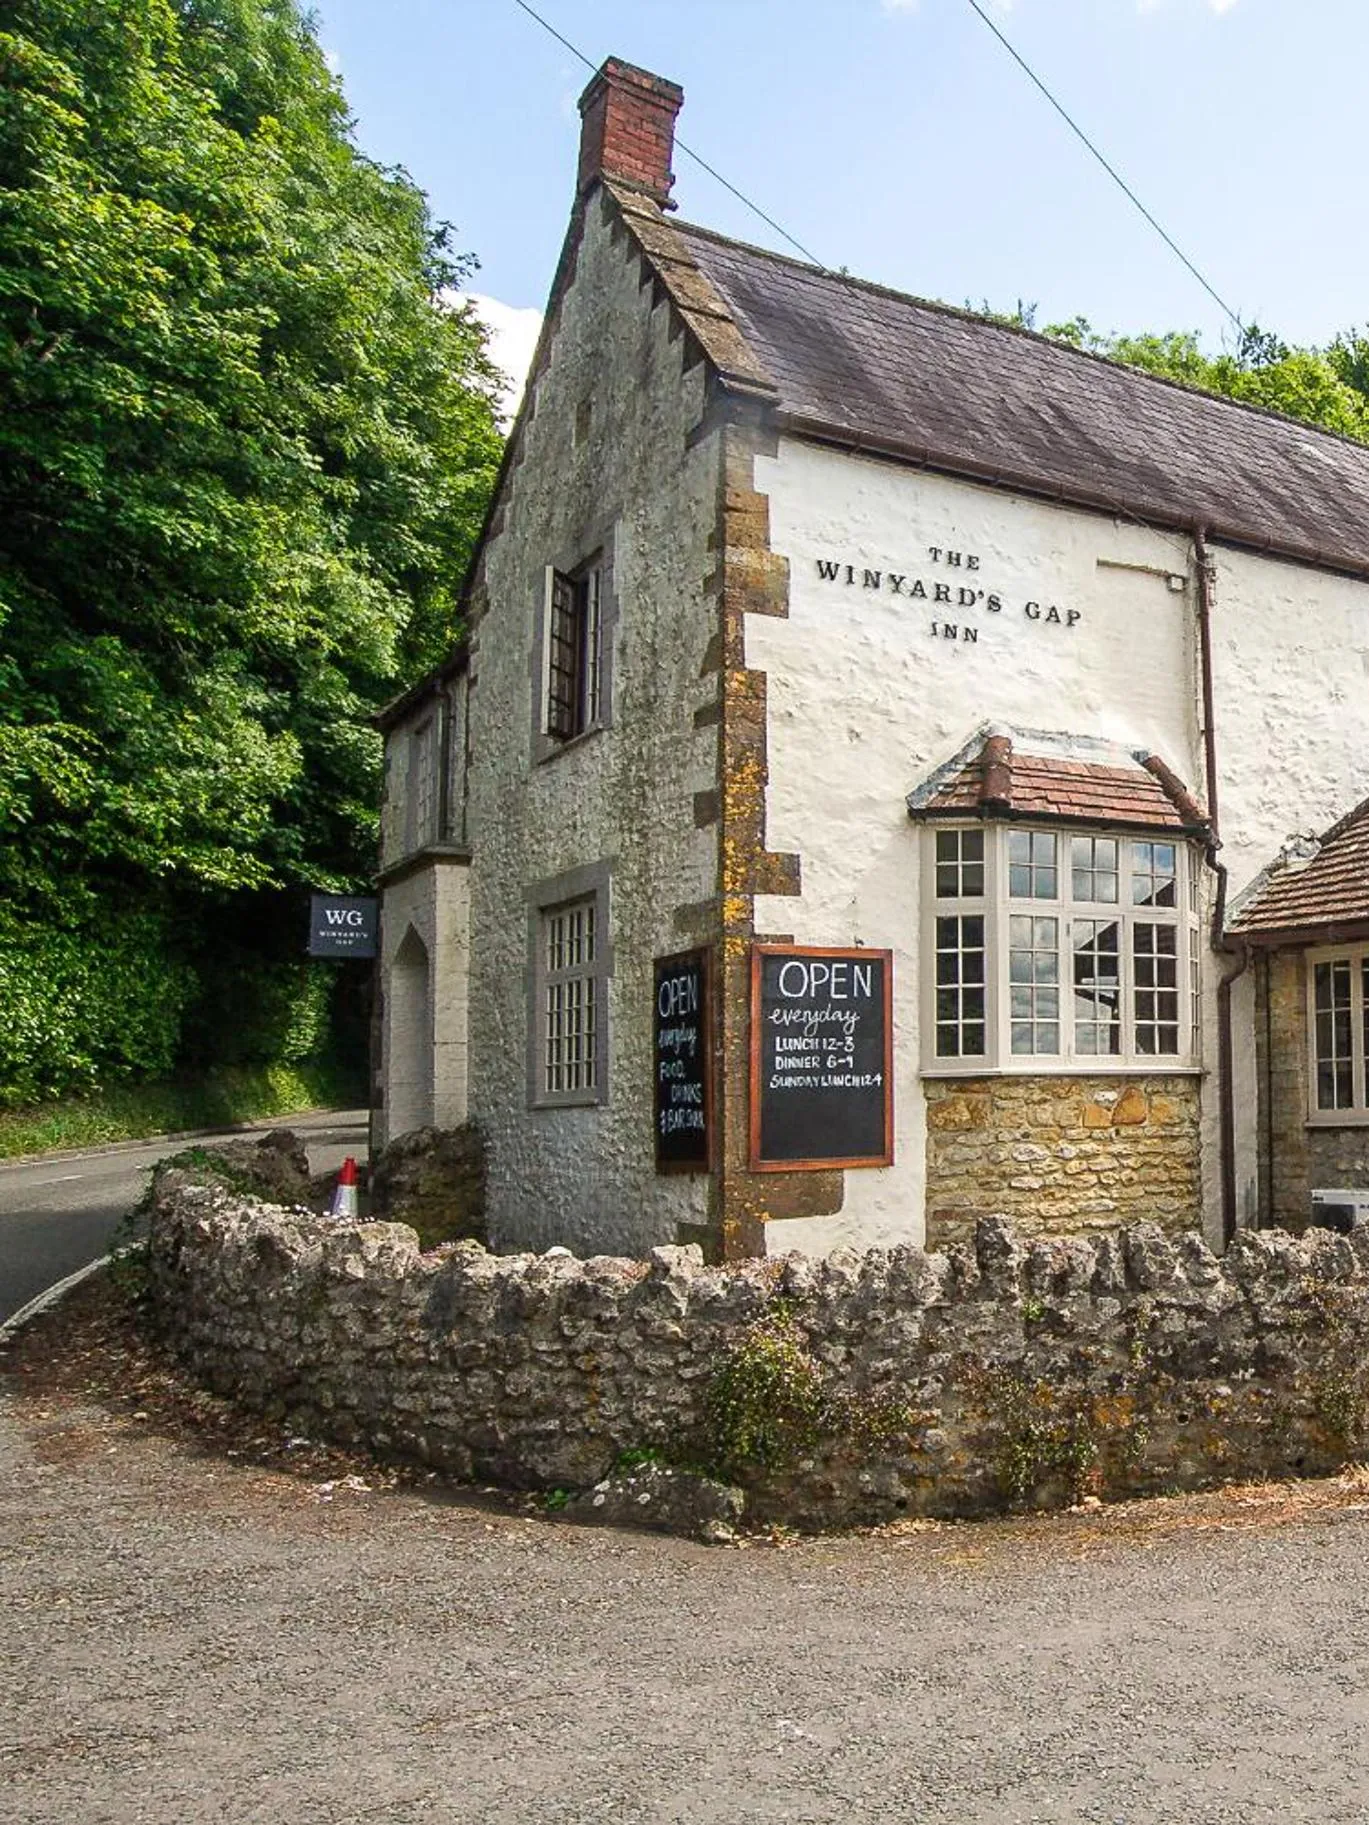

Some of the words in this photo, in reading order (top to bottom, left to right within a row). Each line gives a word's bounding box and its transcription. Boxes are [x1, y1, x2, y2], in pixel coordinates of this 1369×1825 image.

[928, 547, 979, 571] THE
[817, 559, 1001, 612] WINYARD'S
[1025, 601, 1081, 627] GAP
[931, 622, 978, 643] INN
[325, 910, 363, 926] WG
[779, 961, 872, 999] OPEN
[659, 974, 697, 1017] OPEN
[768, 1003, 860, 1037] everyday
[775, 1036, 819, 1052] LUNCH
[822, 1036, 855, 1053] 12-3
[775, 1055, 821, 1070] DINNER
[769, 1074, 820, 1089] SUNDAY
[821, 1074, 860, 1088] LUNCH
